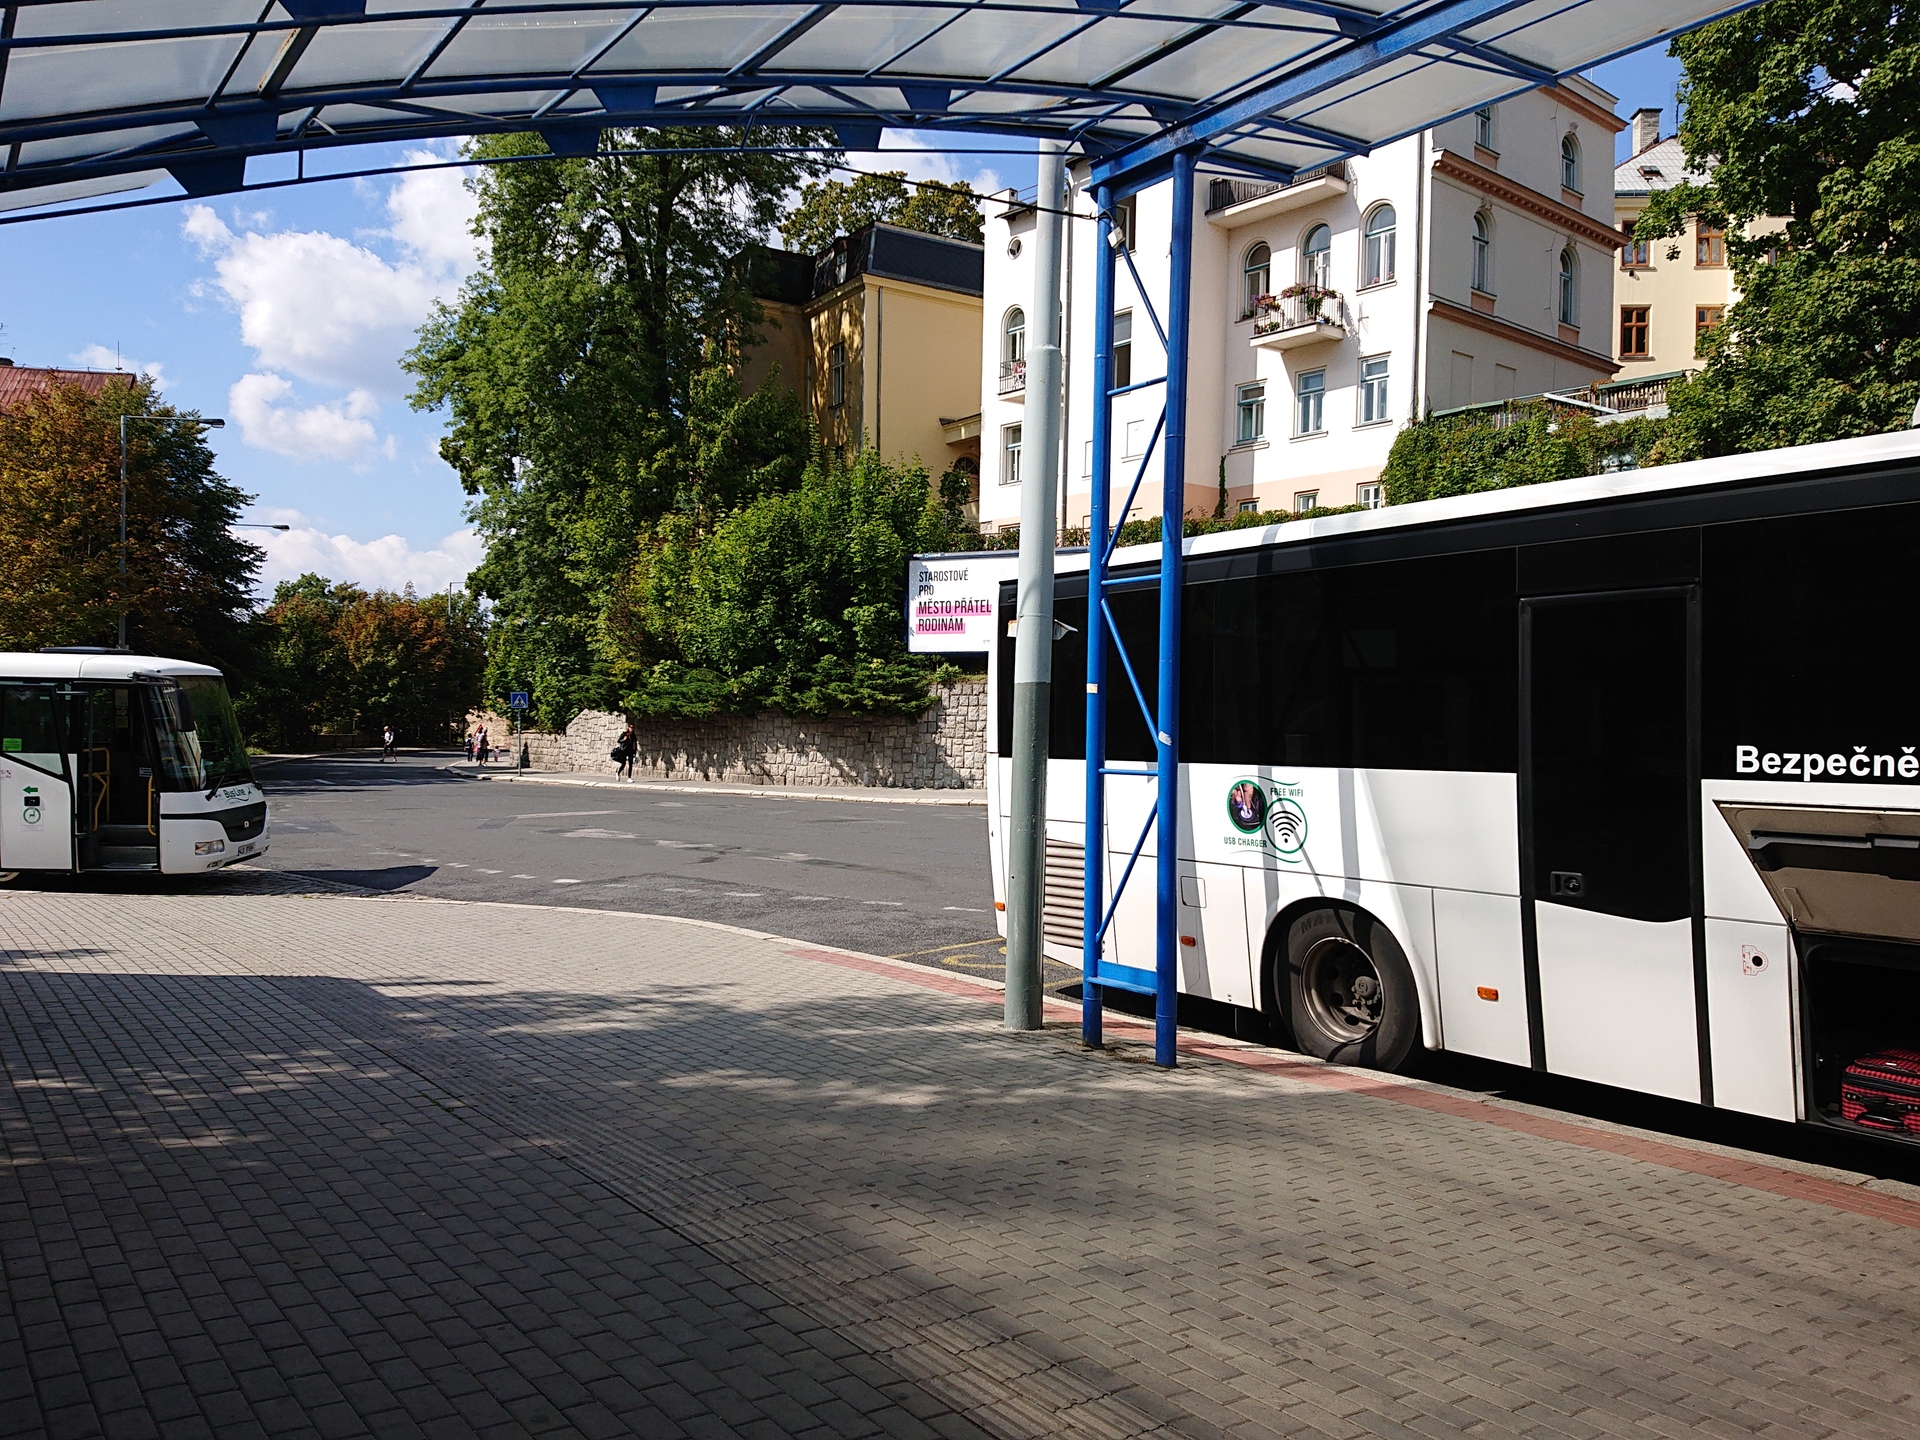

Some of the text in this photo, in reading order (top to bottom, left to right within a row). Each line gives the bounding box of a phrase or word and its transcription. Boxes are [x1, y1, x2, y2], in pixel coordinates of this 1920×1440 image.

[918, 567, 968, 582] STAROSTOVÉ
[918, 584, 935, 596] PRO
[918, 597, 992, 615] MĚSTO PŘÁTEL
[918, 615, 963, 631] RODINÁM
[1736, 745, 1920, 782] Bezpečně
[1270, 787, 1304, 797] FREE WIFI
[1224, 836, 1268, 848] USB CHARGER
